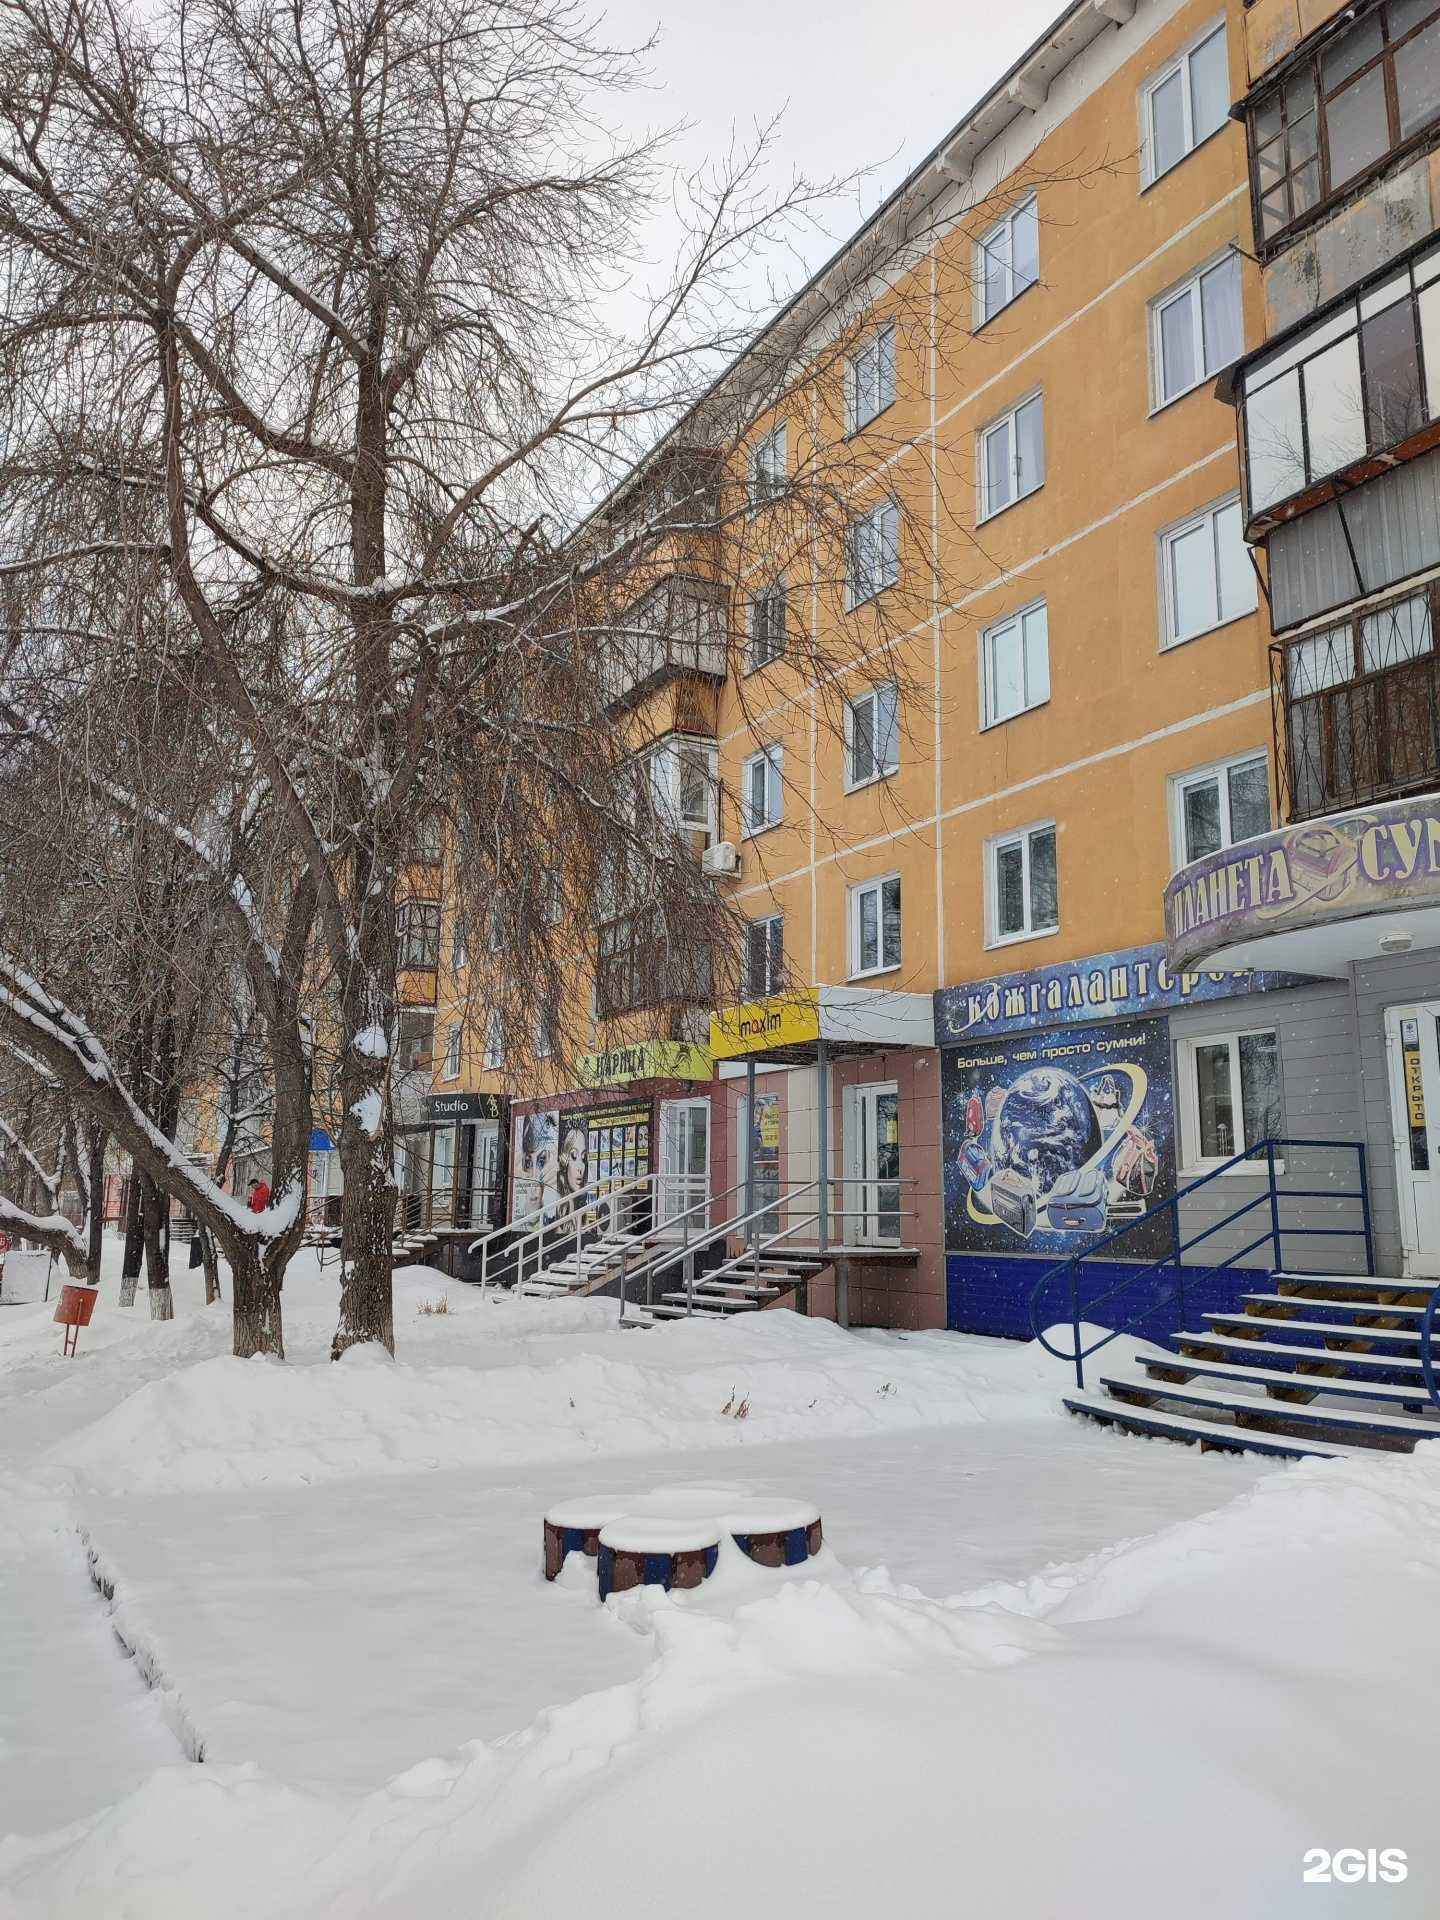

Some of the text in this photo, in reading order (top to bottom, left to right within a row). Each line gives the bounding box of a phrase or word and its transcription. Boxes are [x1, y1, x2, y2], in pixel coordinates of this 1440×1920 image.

[1174, 849, 1294, 939] ПЛАНЕТА
[740, 1009, 782, 1038] maxim
[957, 1032, 1146, 1069] Больше, чем просто сумки!
[434, 1100, 469, 1112] Studio
[1409, 1057, 1426, 1121] ОТКРЫТО
